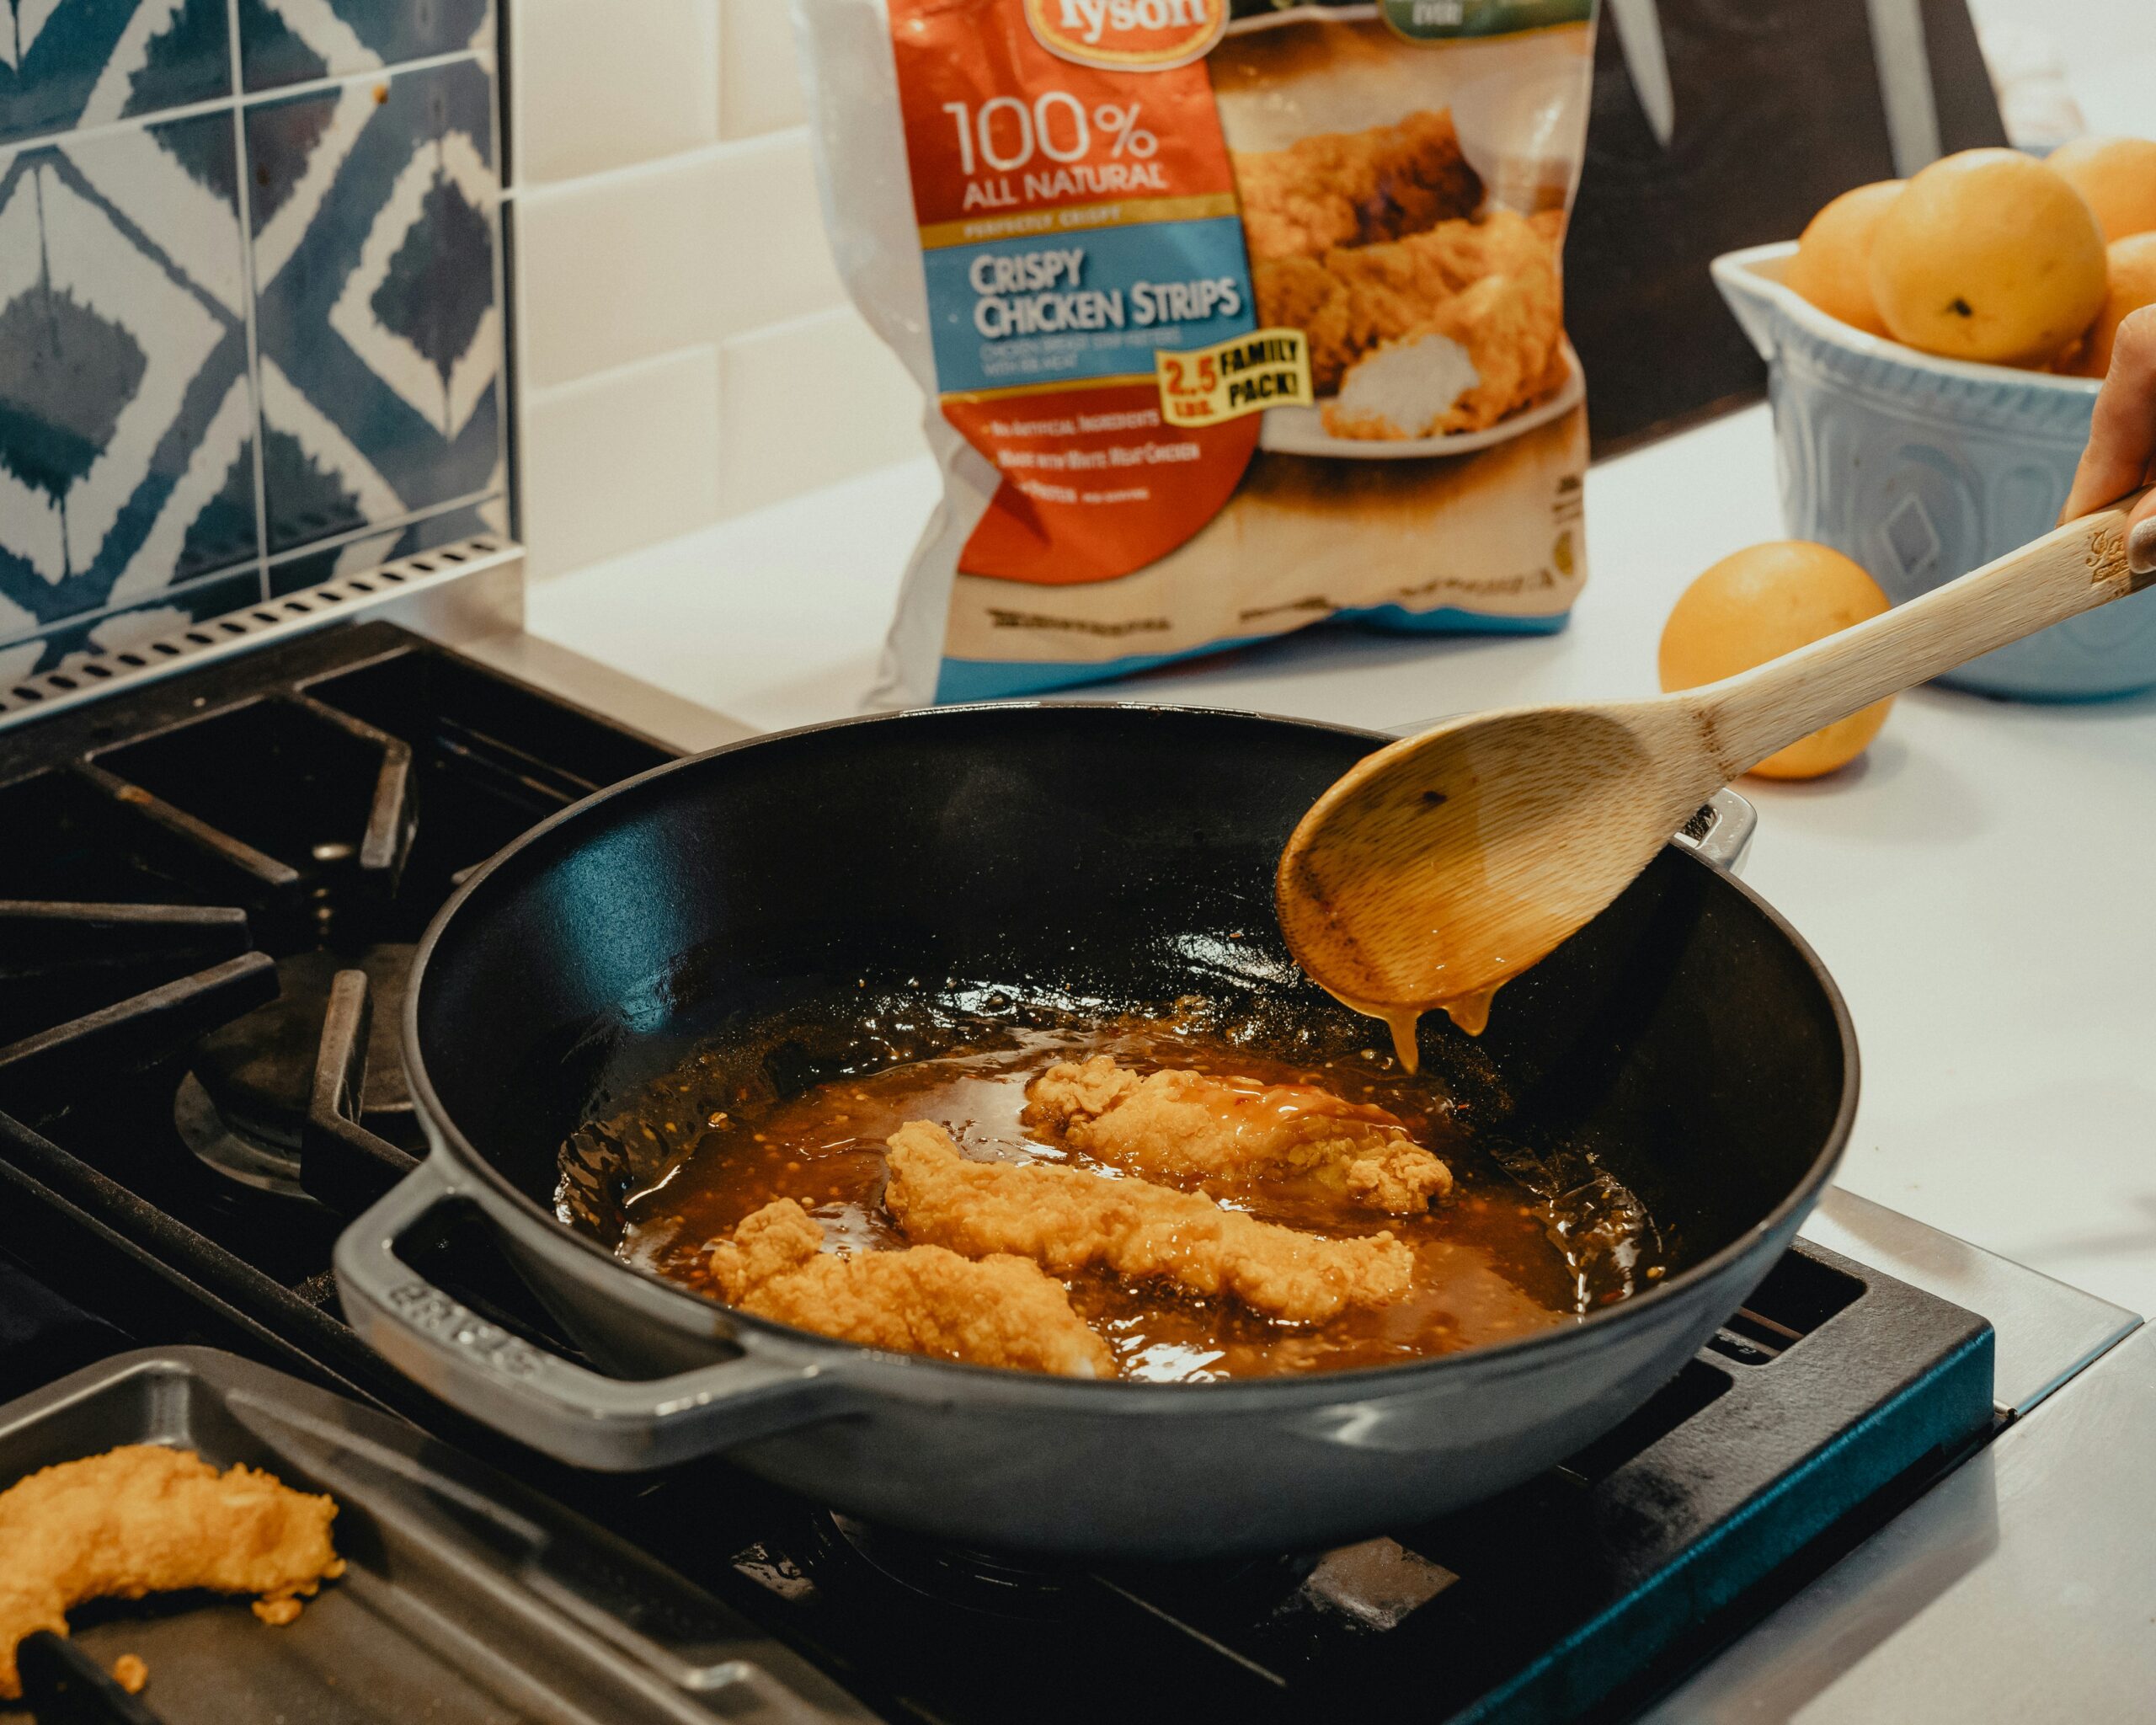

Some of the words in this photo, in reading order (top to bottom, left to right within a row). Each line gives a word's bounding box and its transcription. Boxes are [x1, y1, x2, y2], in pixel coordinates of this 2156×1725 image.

[942, 92, 1158, 175] 100%
[963, 178, 1017, 211] ALL
[970, 248, 1084, 296] CRISPY
[974, 289, 1124, 339] CHICKEN
[1131, 278, 1241, 325] STRIPS
[1164, 355, 1217, 396] 2.5
[1220, 339, 1298, 377] FAMILY
[1229, 372, 1298, 409] PACK!
